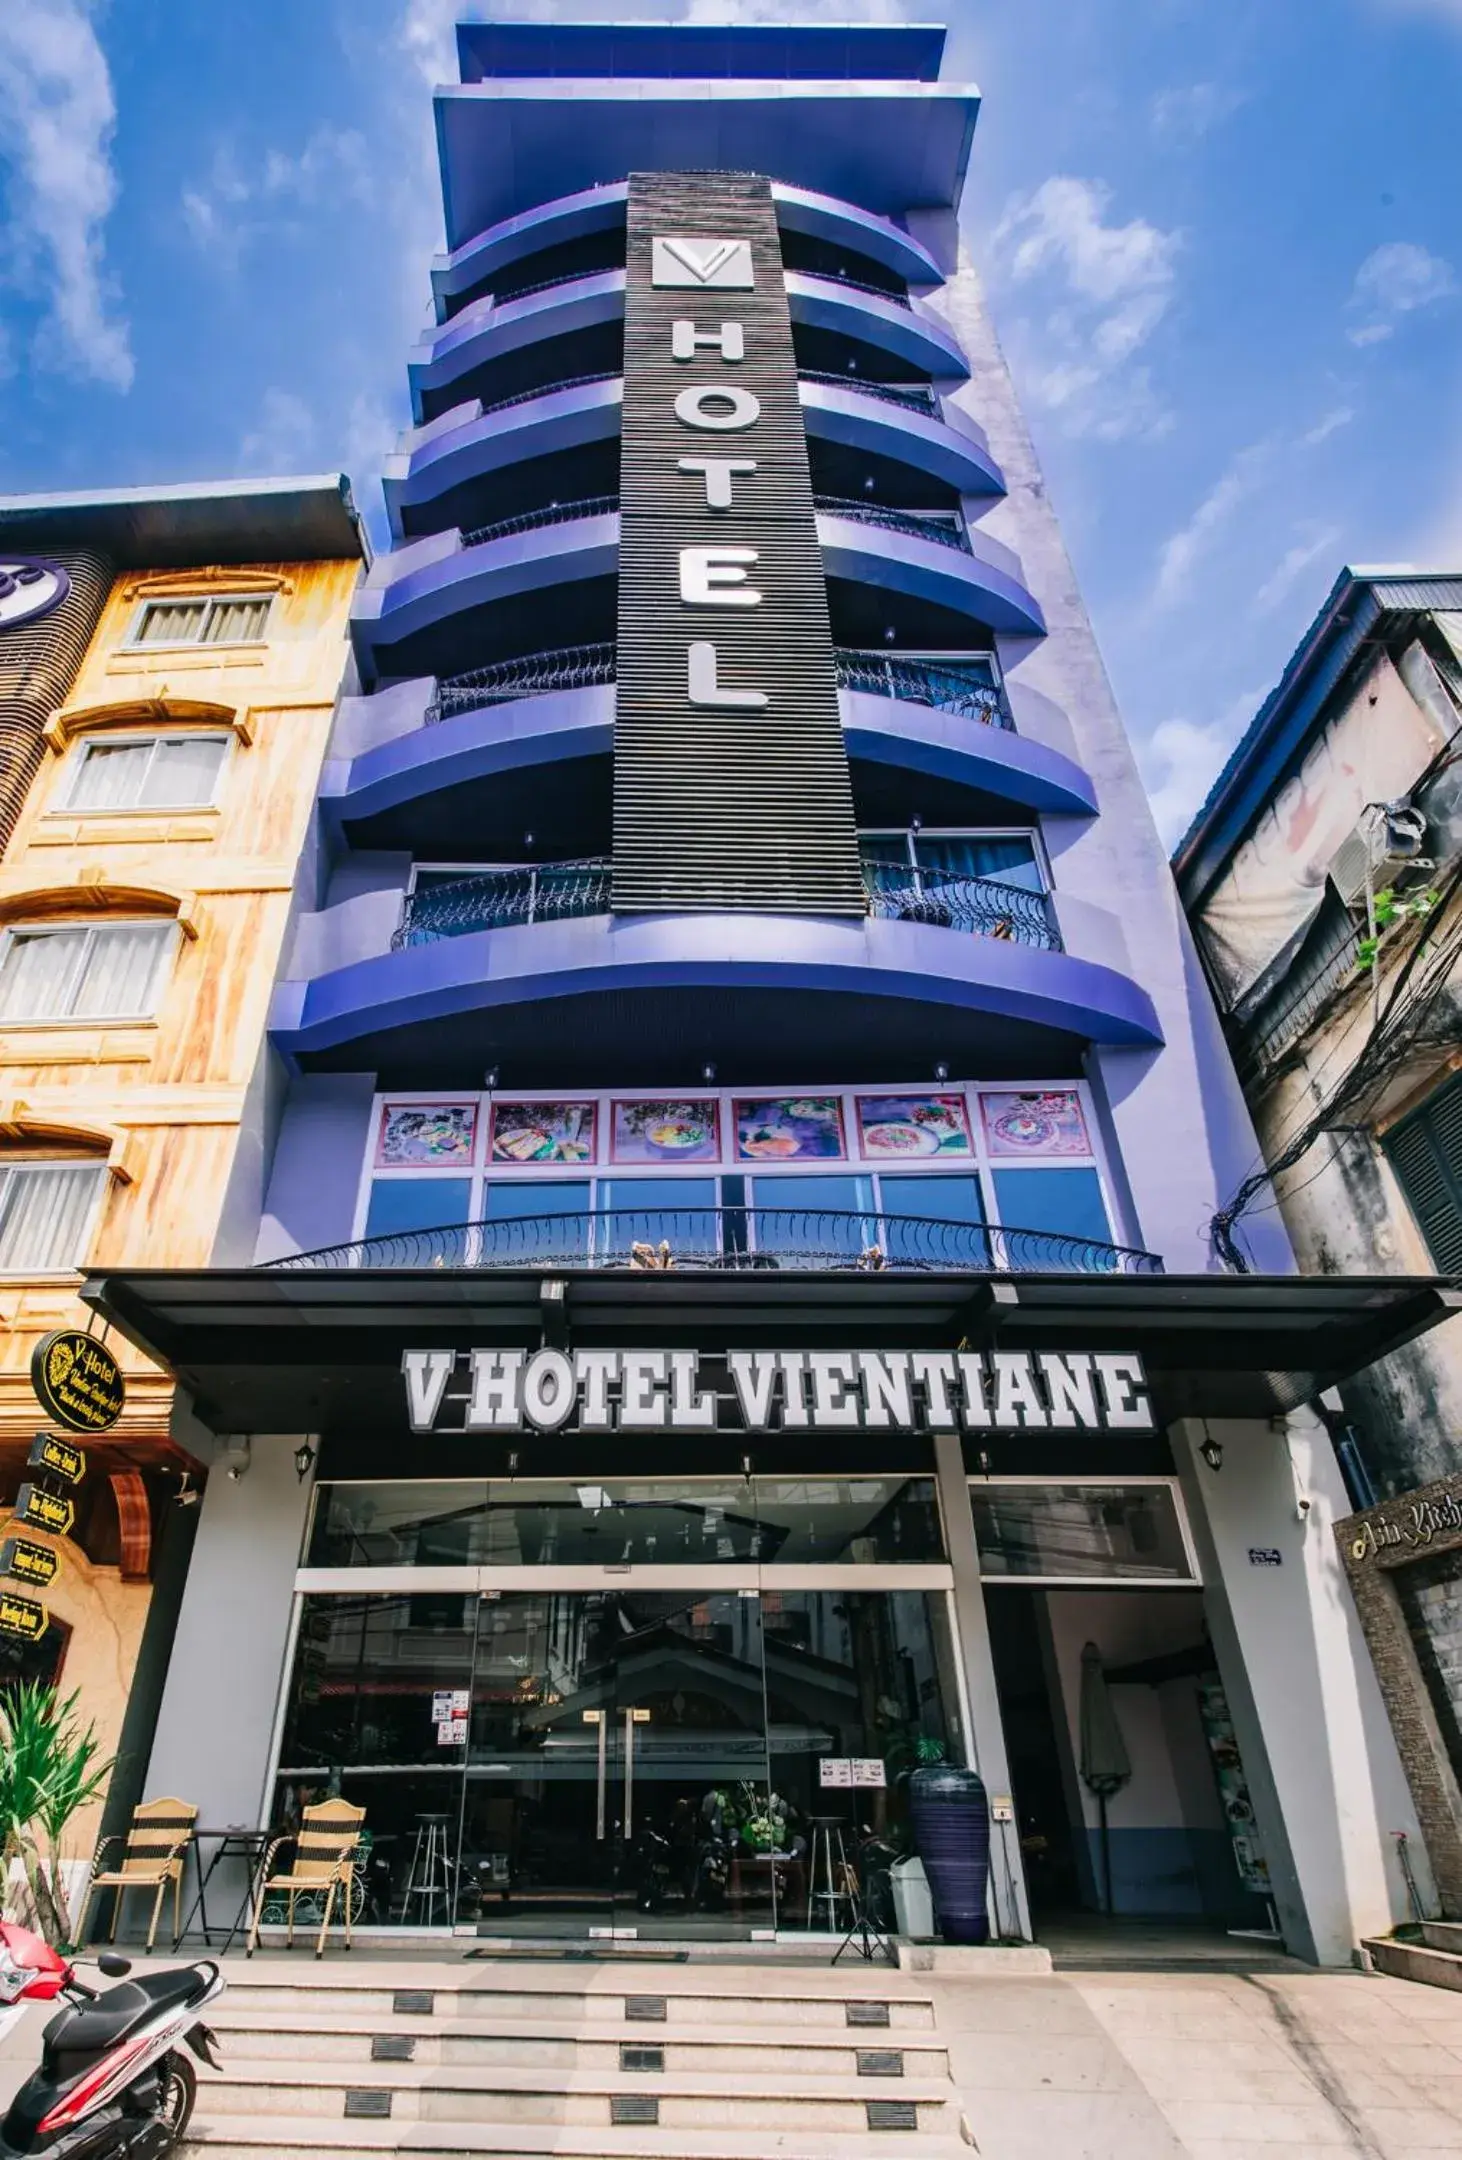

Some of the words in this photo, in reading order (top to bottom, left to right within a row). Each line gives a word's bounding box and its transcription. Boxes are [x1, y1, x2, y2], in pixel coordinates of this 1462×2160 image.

[661, 239, 742, 283] V
[671, 320, 770, 710] HOTEL
[82, 1350, 117, 1385] Hotel
[402, 1348, 457, 1432] V
[462, 1346, 719, 1436] HOTEL
[726, 1348, 1160, 1438] VIENTIANE
